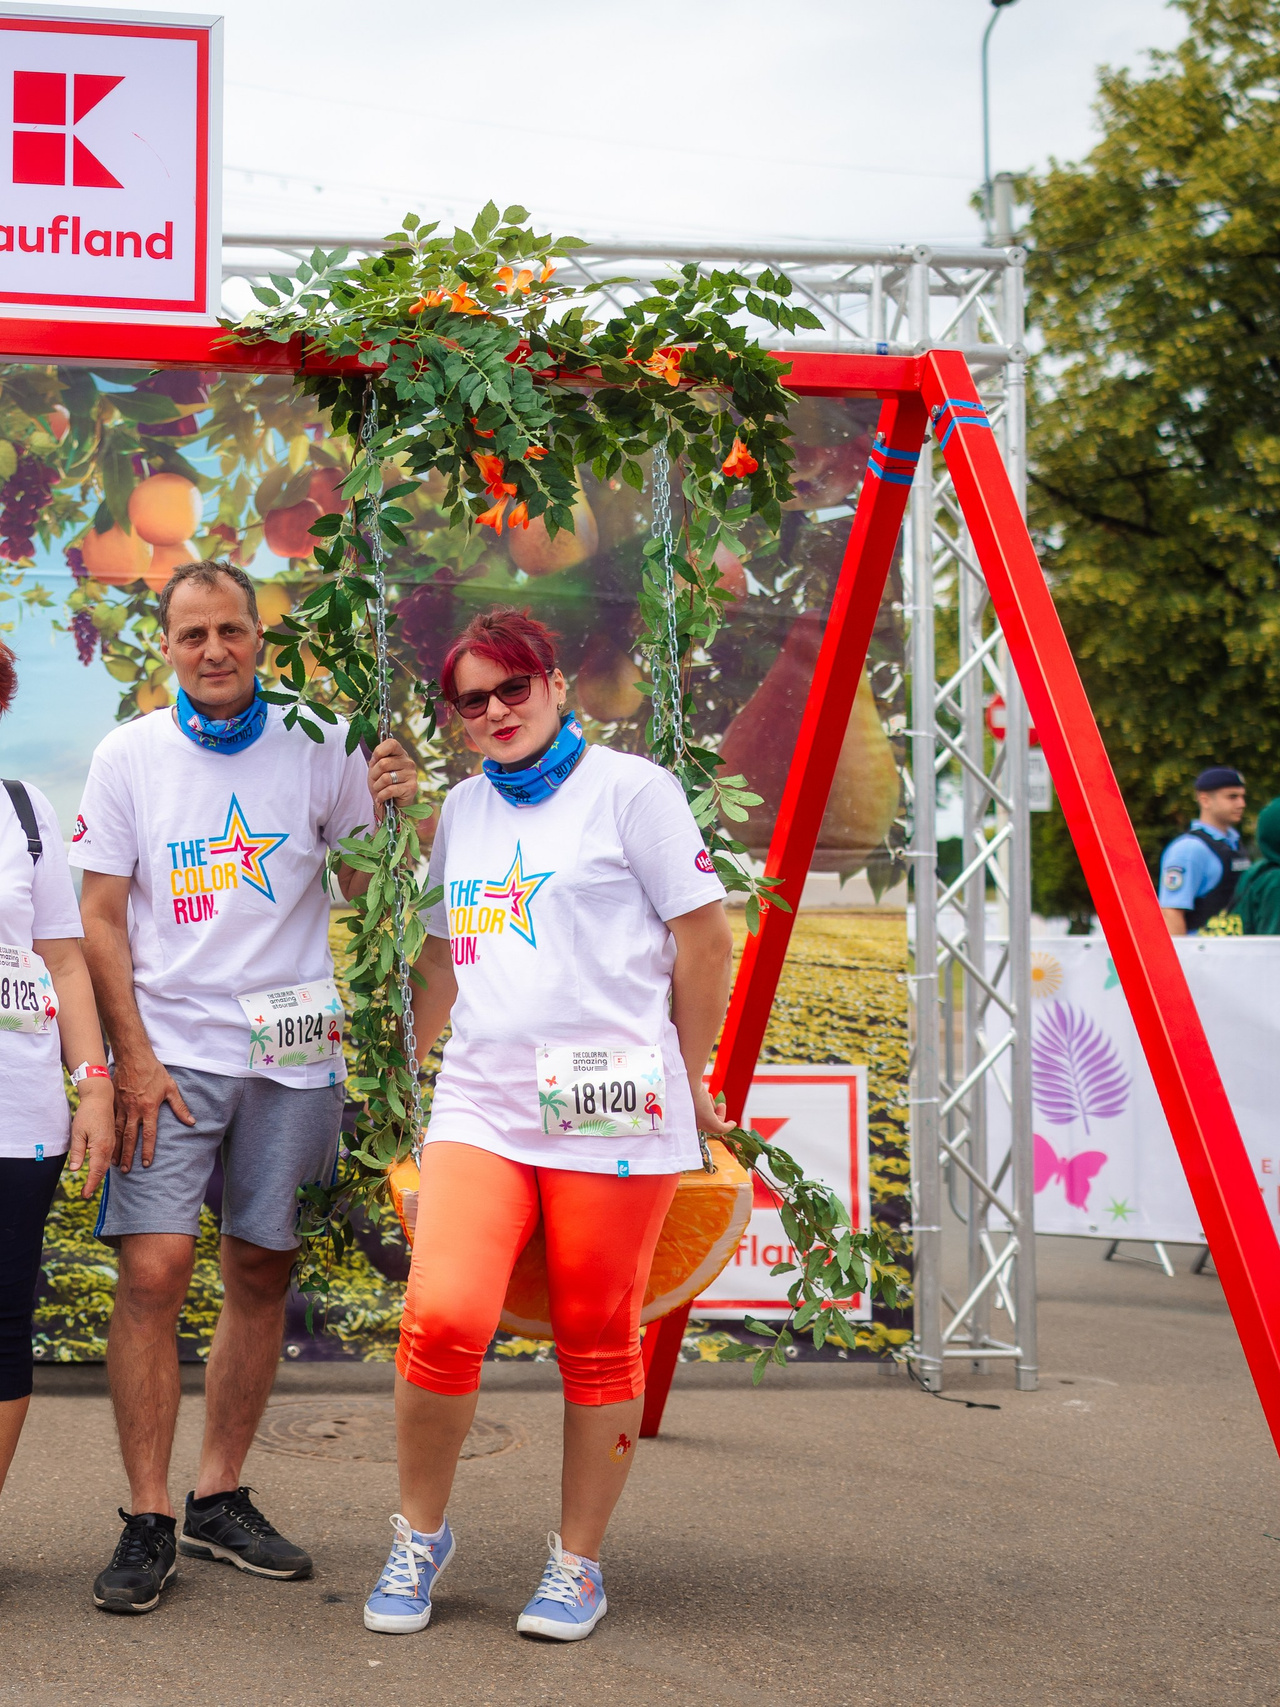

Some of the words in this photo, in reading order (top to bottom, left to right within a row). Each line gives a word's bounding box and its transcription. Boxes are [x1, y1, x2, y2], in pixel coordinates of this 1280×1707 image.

[167, 838, 208, 869] THE
[170, 862, 239, 896] COLOR
[450, 879, 483, 908] THE
[269, 996, 297, 1004] amazing
[276, 1013, 323, 1048] 18124
[572, 1057, 608, 1066] amazing
[571, 1080, 637, 1115] 18120
